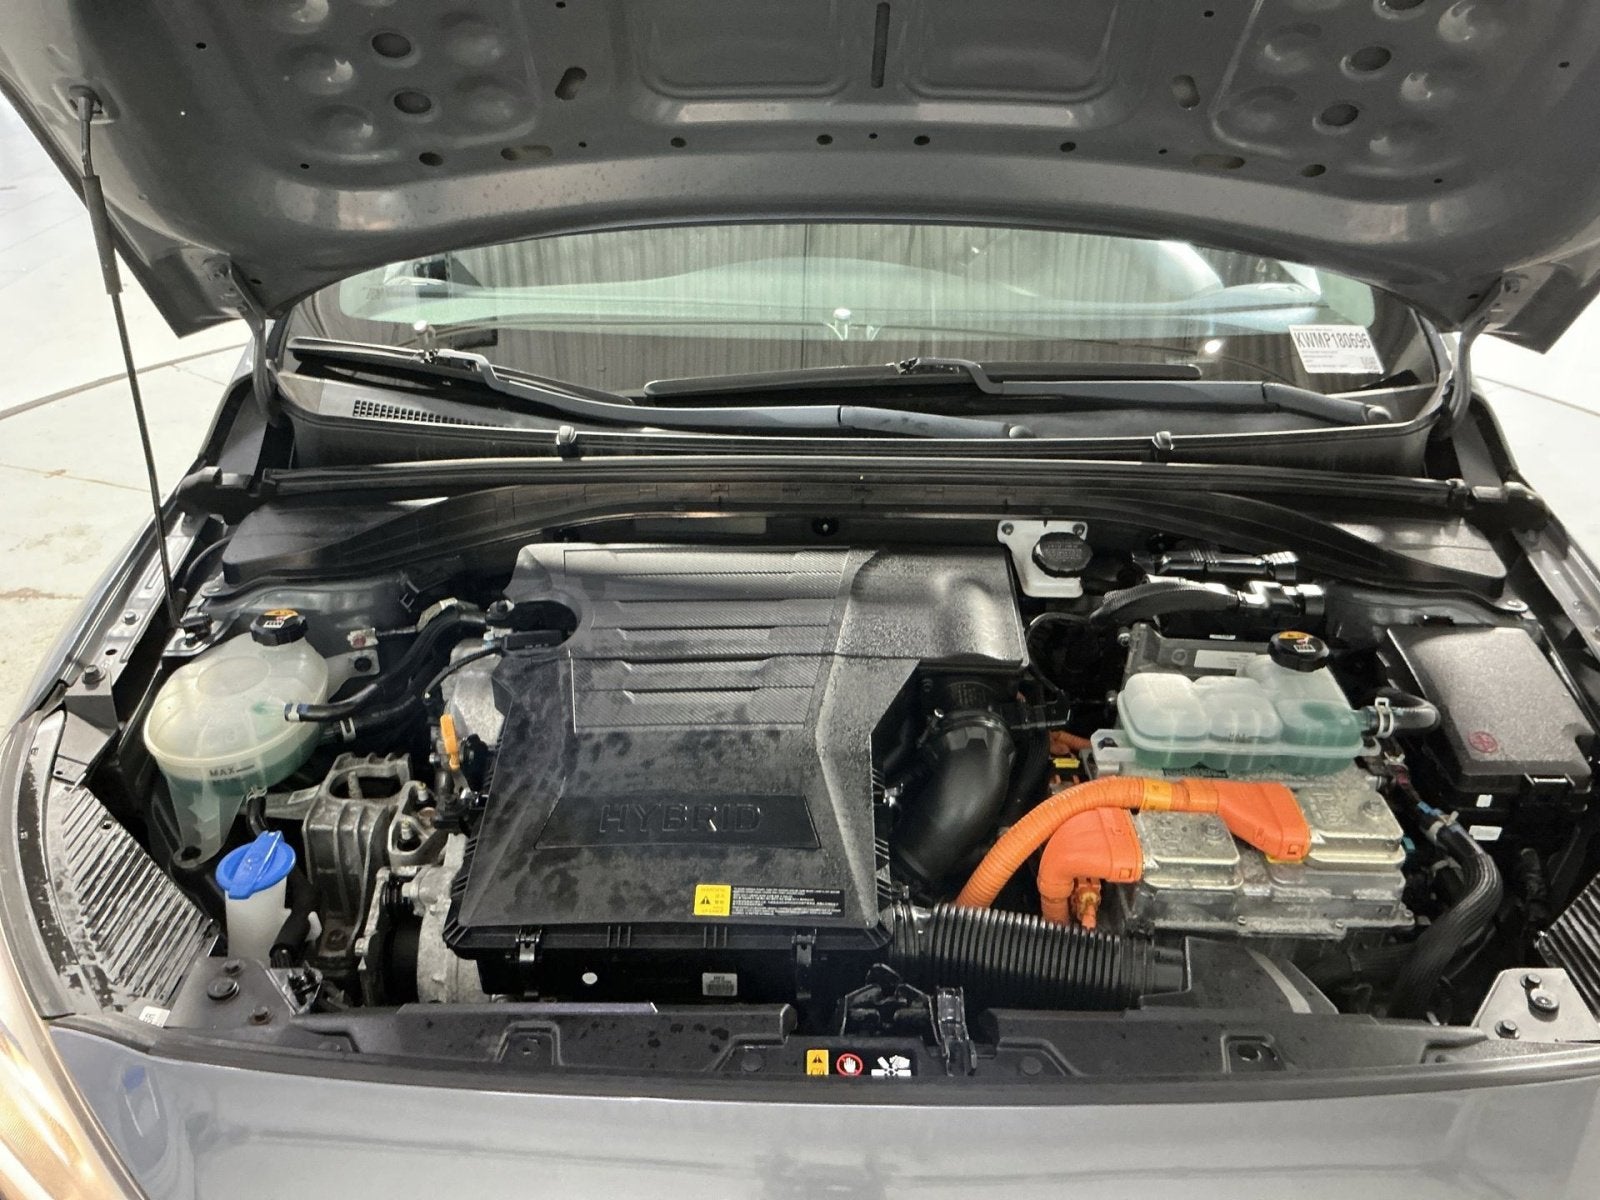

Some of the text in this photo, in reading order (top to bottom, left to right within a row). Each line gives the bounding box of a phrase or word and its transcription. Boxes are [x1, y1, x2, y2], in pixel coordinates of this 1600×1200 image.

[1294, 332, 1371, 348] KWMP180696
[209, 766, 235, 777] MAX
[599, 803, 761, 832] HYBRID
